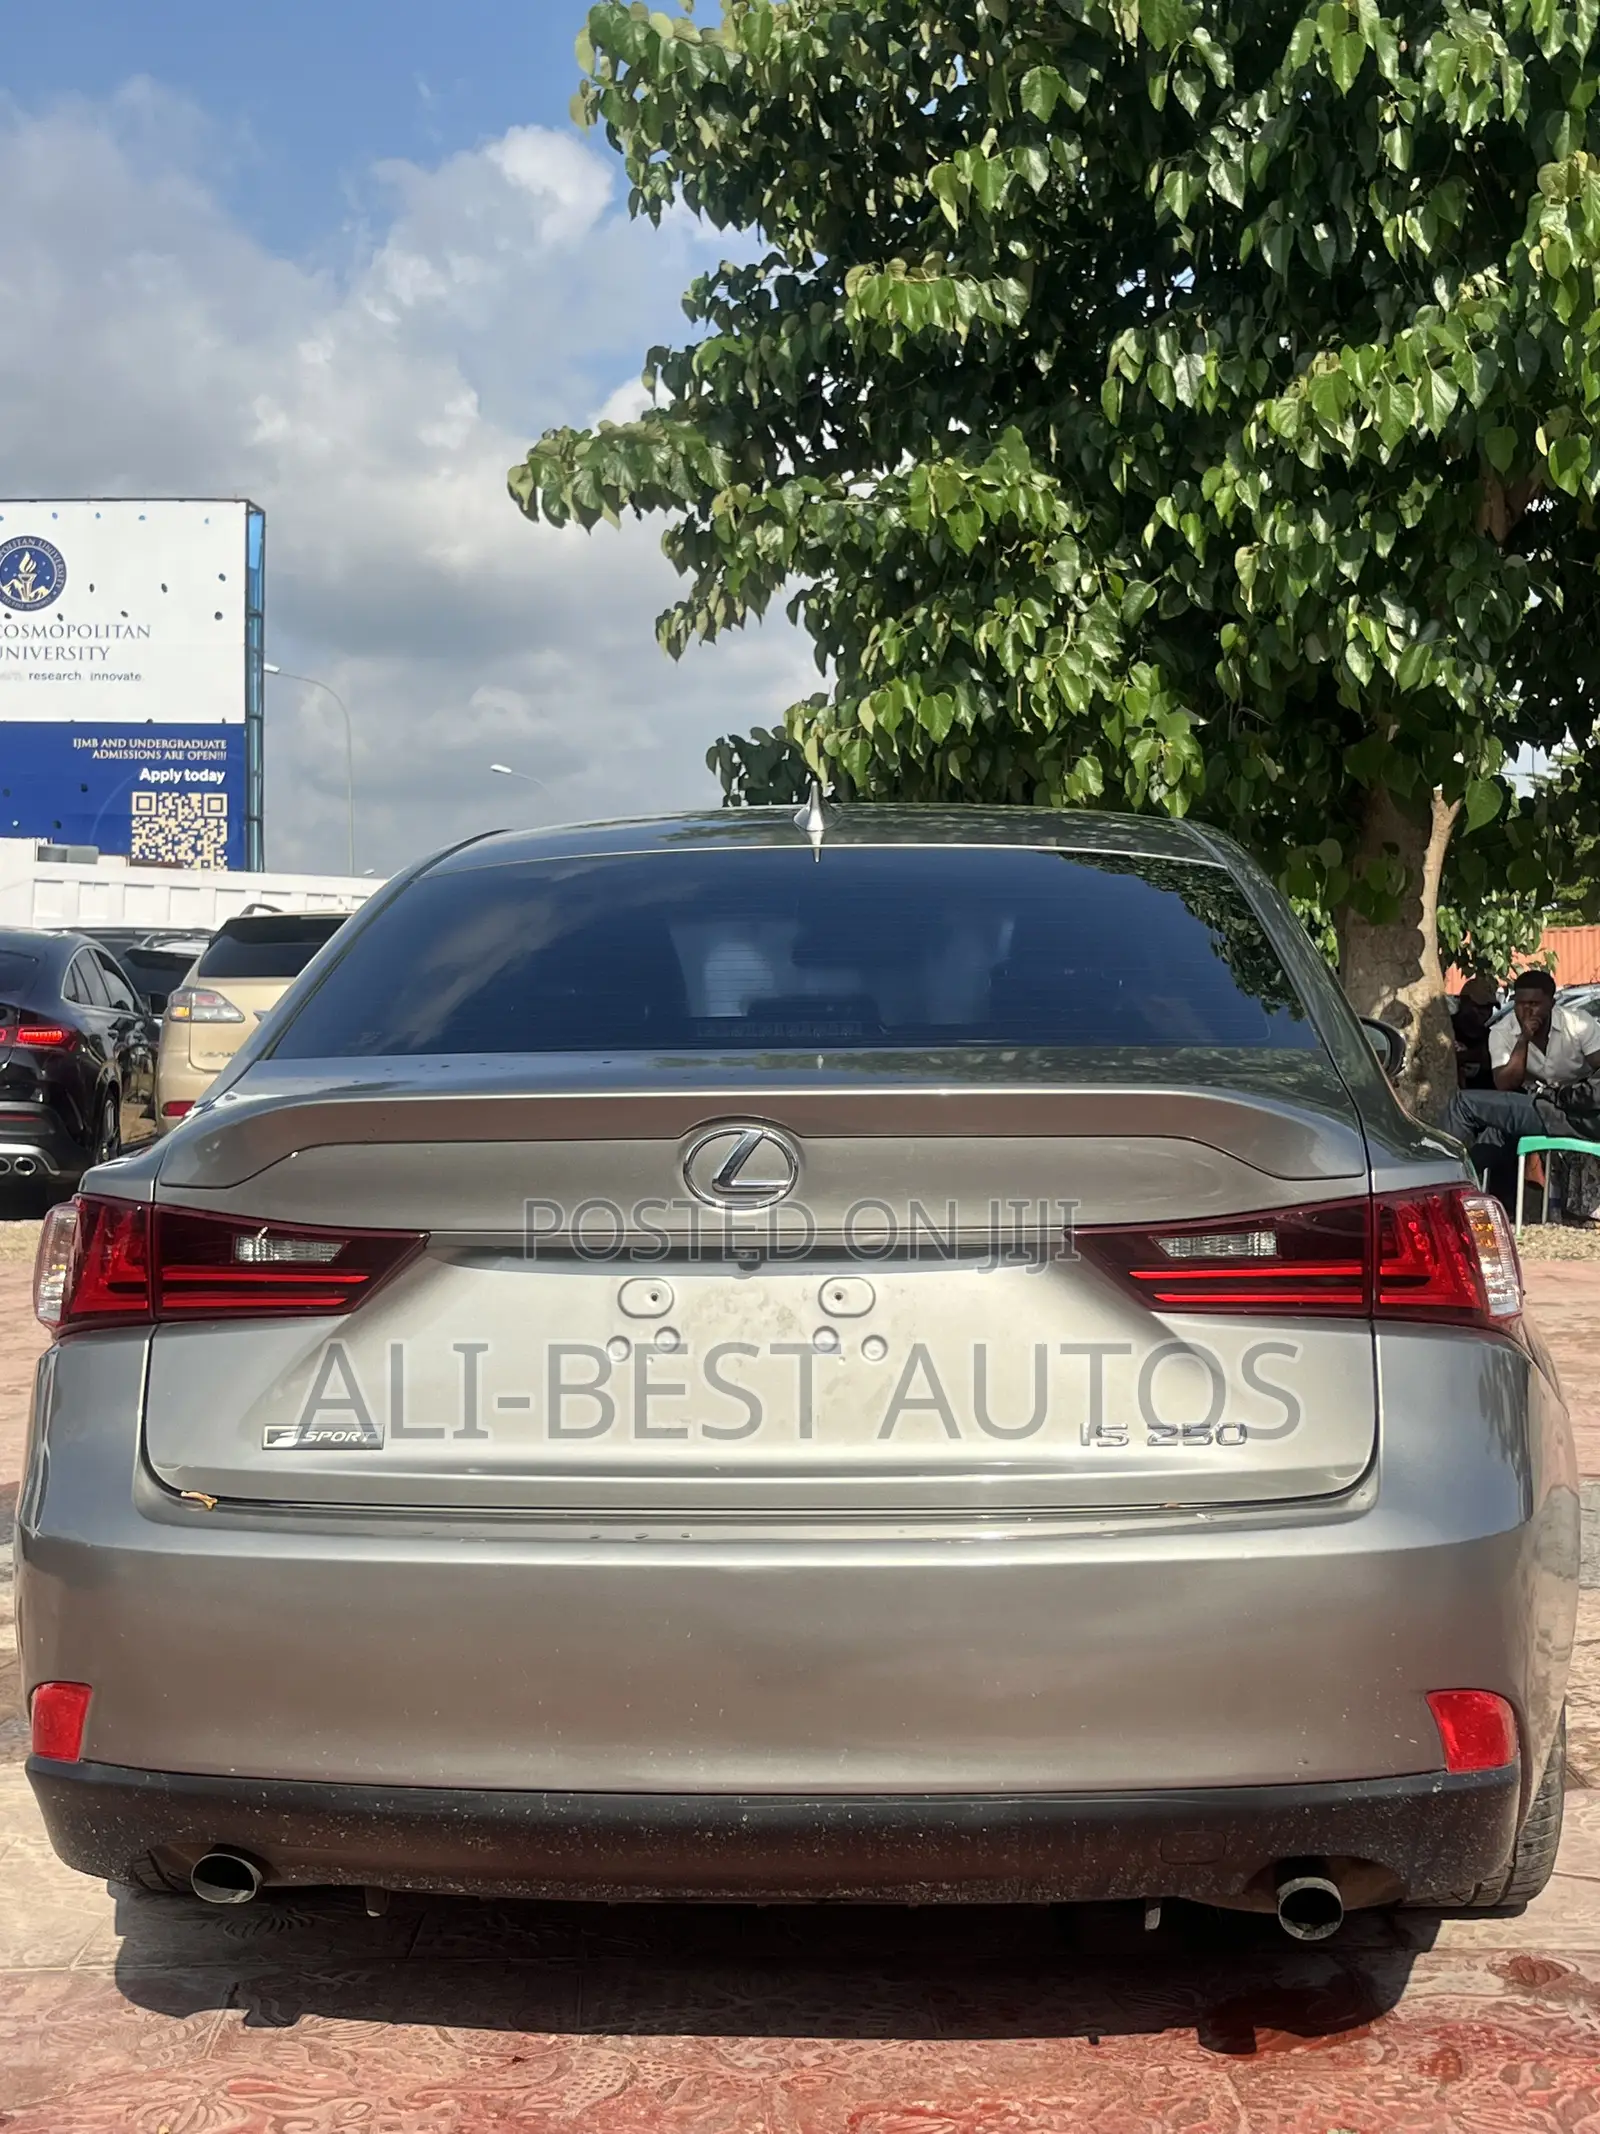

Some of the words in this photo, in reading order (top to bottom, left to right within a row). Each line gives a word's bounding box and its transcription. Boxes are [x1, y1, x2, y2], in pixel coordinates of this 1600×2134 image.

[73, 738, 98, 750] IJMB
[101, 739, 126, 749] AND
[129, 739, 227, 750] UNDERGRADUATE
[92, 749, 161, 760] ADMISSIONS
[164, 750, 184, 761] ARE
[187, 751, 227, 761] OPEN!!!
[139, 767, 182, 784] Apply
[184, 768, 226, 785] today
[1079, 1421, 1130, 1447] IS
[1146, 1421, 1249, 1447] 250
